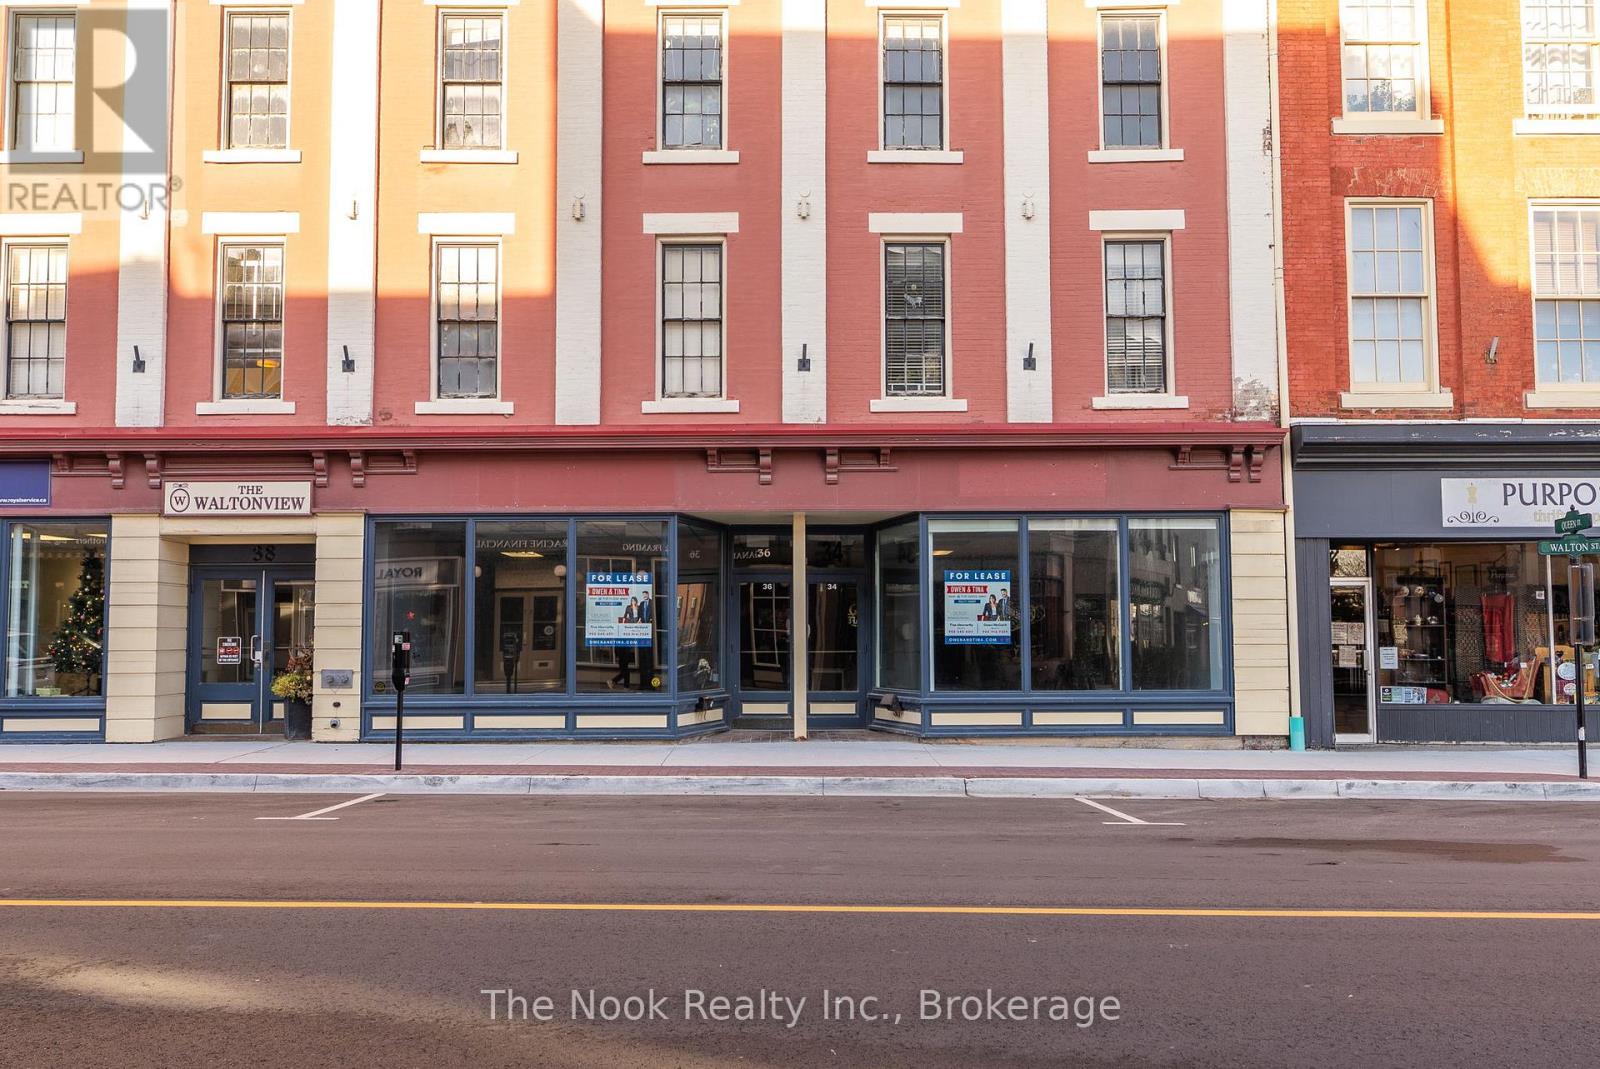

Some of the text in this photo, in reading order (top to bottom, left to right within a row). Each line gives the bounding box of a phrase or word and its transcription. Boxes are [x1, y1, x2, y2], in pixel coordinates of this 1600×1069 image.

[238, 485, 263, 495] THE
[1502, 482, 1600, 506] PURPO
[174, 496, 187, 505] W
[194, 496, 306, 510] WALTONVIEW
[1550, 543, 1589, 552] WALTON
[252, 544, 276, 562] 38
[757, 548, 771, 558] 36
[591, 574, 649, 583] FOR LEASE
[949, 572, 1006, 580] FOR LEASE
